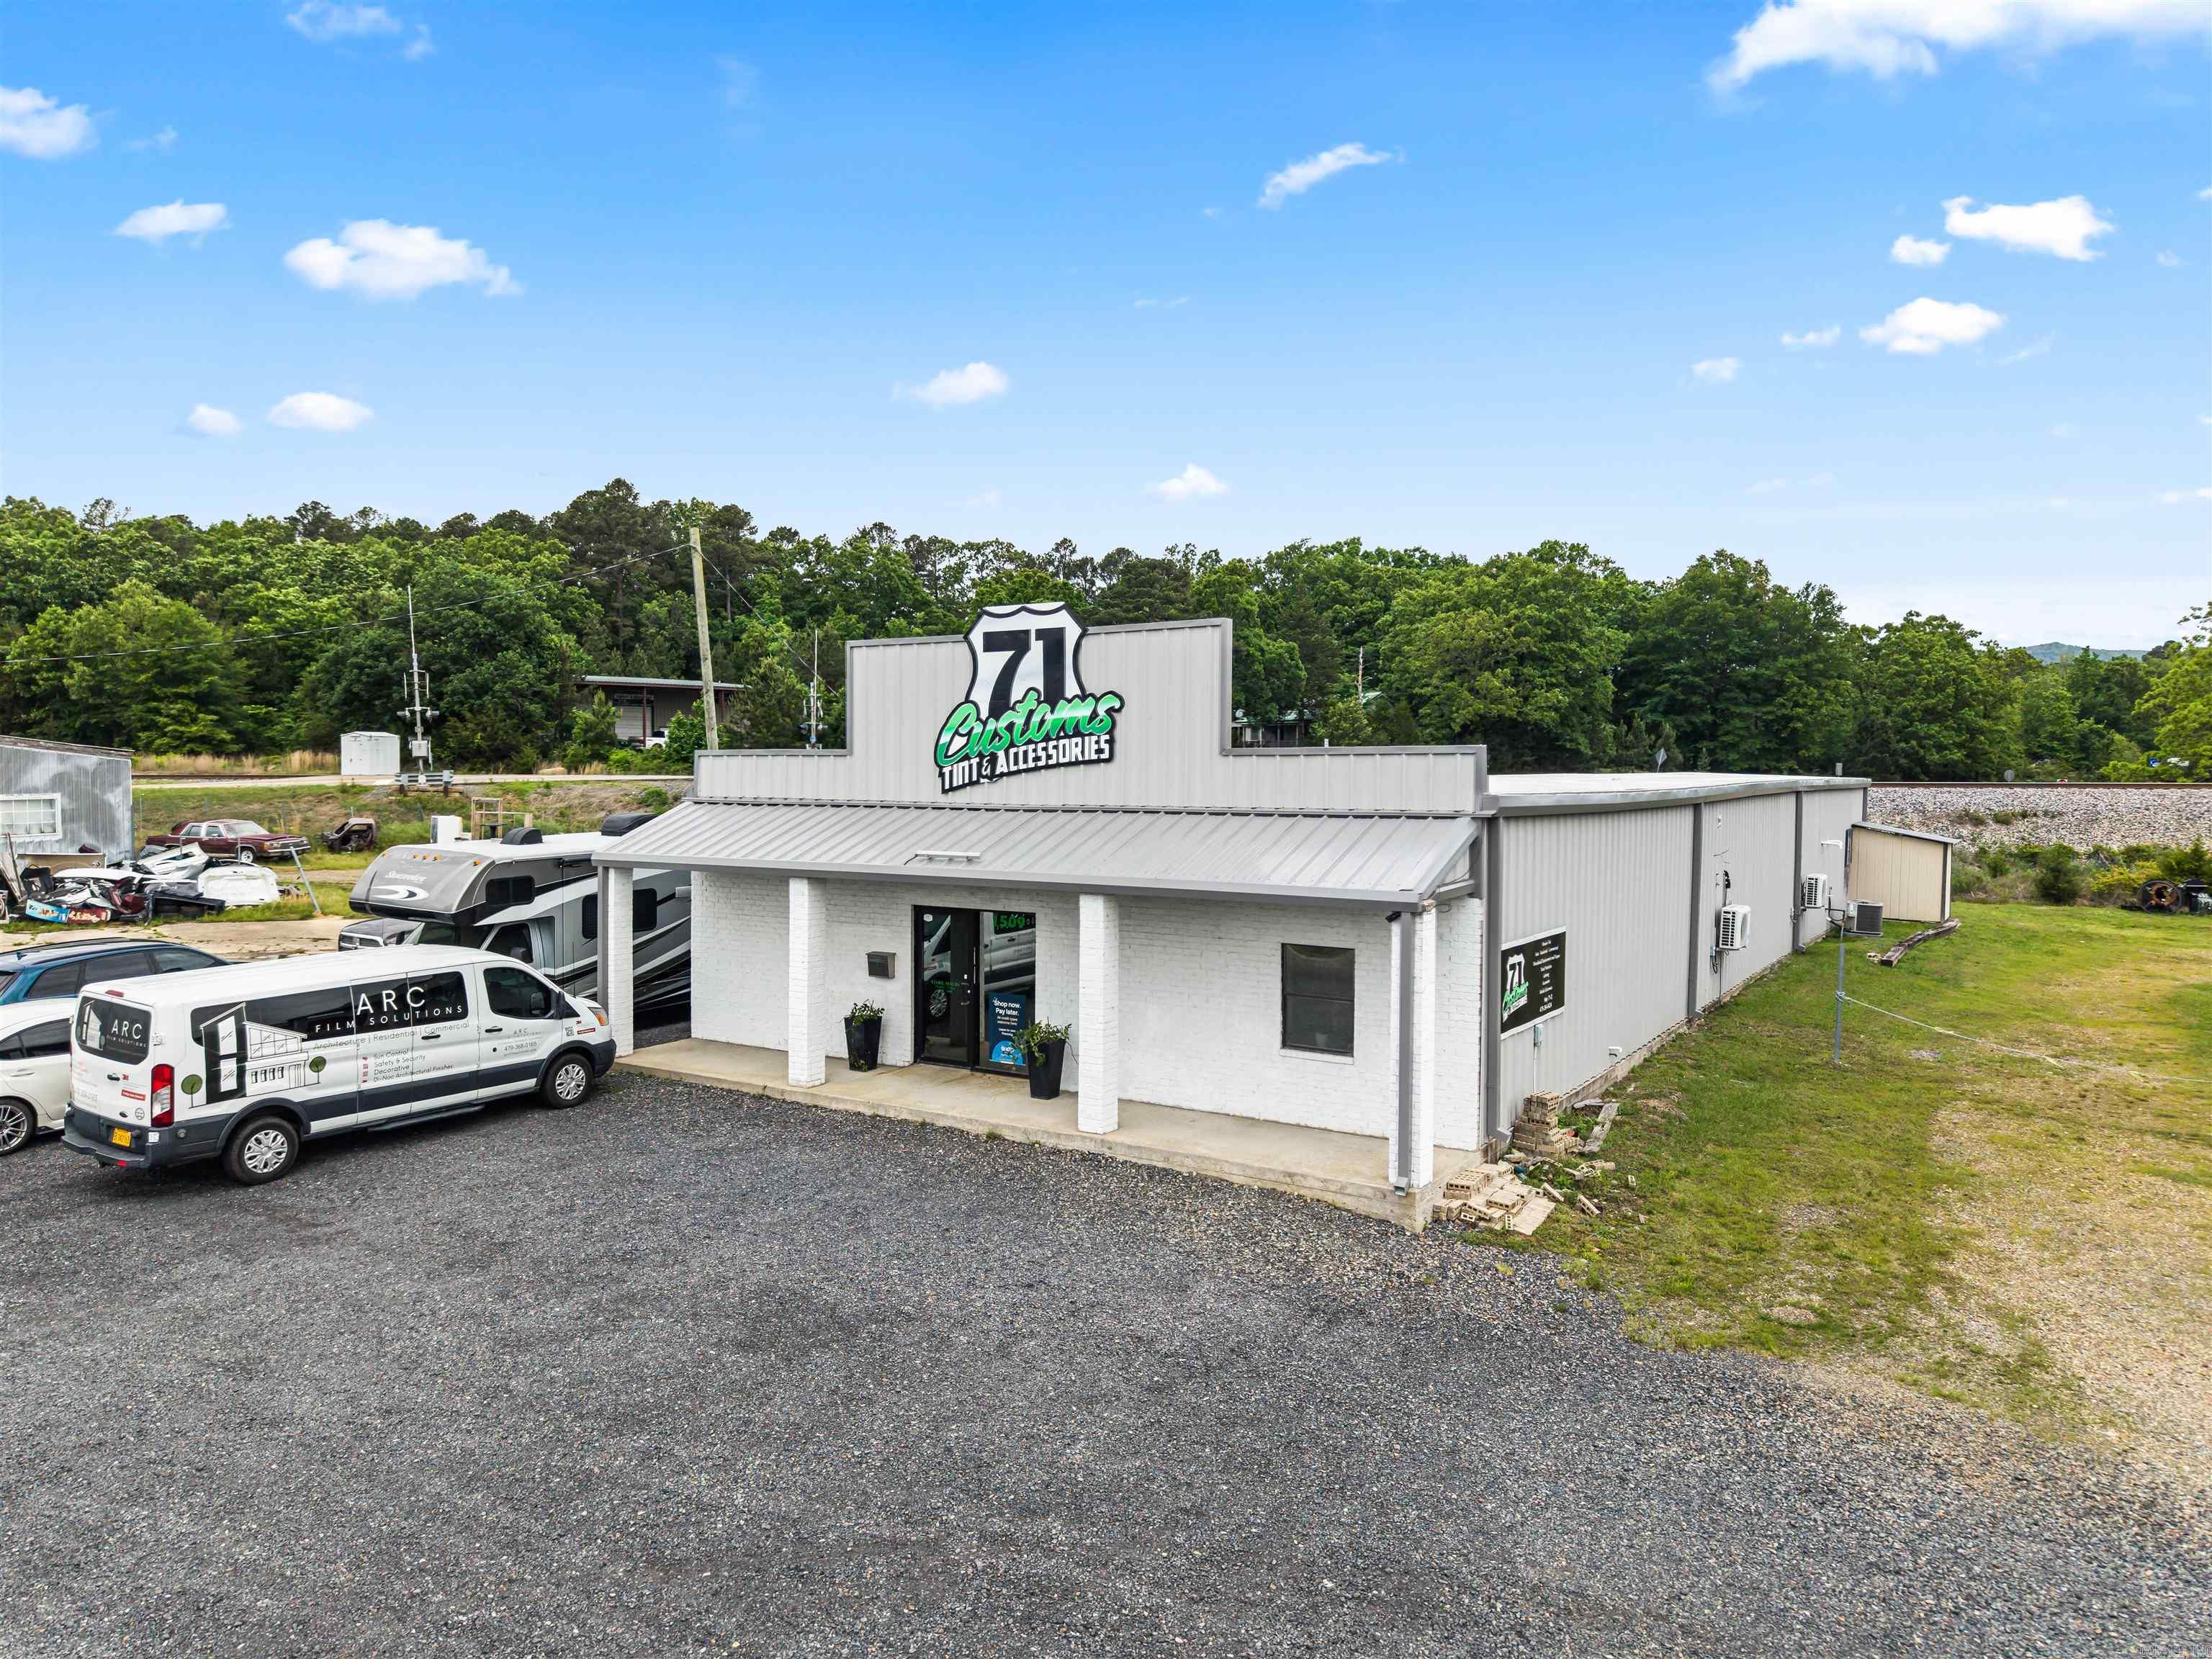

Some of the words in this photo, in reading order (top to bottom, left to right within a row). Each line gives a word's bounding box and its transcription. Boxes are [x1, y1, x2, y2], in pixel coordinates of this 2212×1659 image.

[983, 627, 1066, 718] 71
[937, 691, 1120, 766] Customs
[943, 757, 980, 790] TINT
[982, 756, 992, 777] &
[997, 734, 1110, 775] ACCESSORIES
[1509, 961, 1523, 995] 71
[356, 986, 426, 1015] ARC
[112, 1019, 143, 1039] ARC
[315, 1020, 355, 1033] FILM
[369, 1006, 462, 1025] SOLUTIONS
[374, 1029, 418, 1043] Residential
[424, 1019, 469, 1034] Commercial
[385, 1048, 409, 1058] Control
[402, 1054, 426, 1063] Security
[374, 1065, 410, 1076] Decorative
[395, 1066, 432, 1079] Architectural
